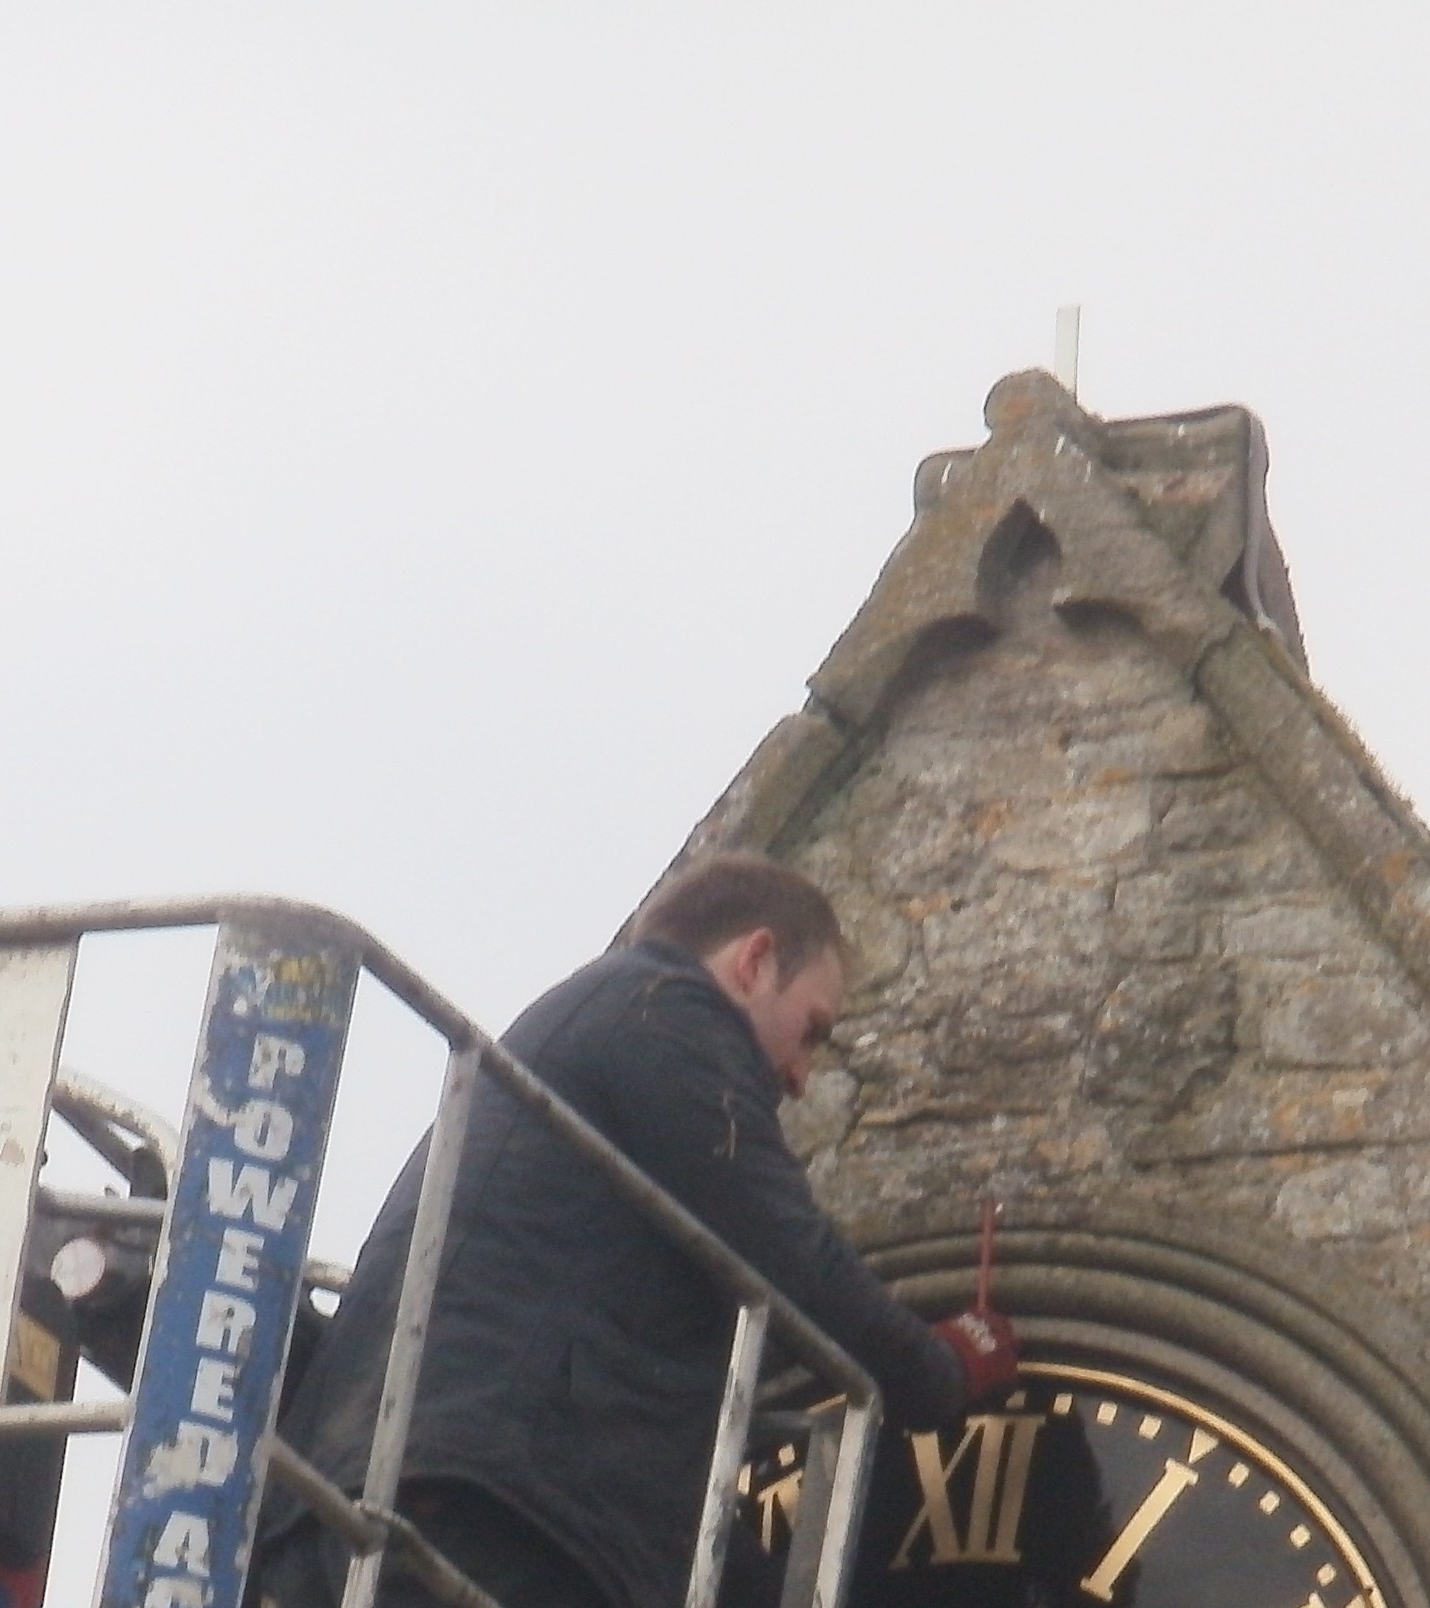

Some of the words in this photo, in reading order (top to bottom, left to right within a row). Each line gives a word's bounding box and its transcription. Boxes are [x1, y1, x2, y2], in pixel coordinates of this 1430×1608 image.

[174, 1030, 306, 1487] POWERED
[889, 1415, 1046, 1569] XII
[1081, 1460, 1196, 1600] I
